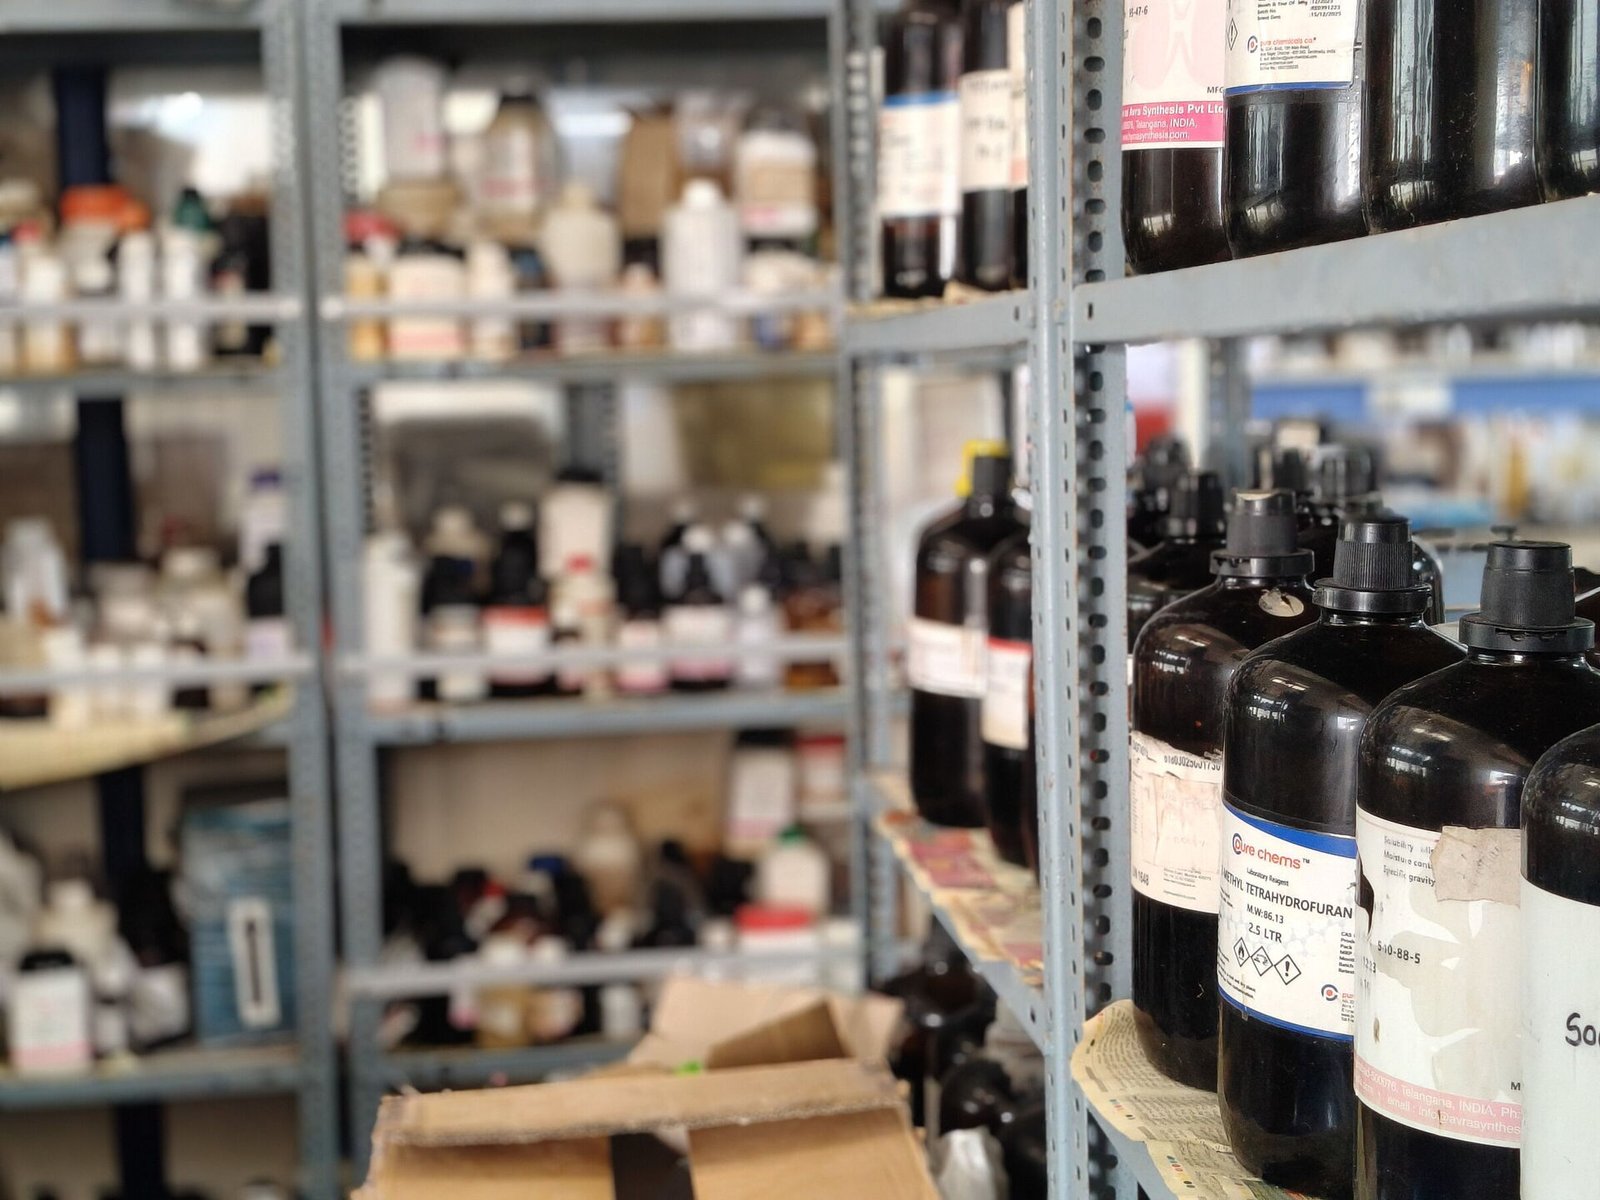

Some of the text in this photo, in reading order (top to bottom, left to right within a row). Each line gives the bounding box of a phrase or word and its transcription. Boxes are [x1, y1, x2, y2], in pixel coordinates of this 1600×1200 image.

[1142, 104, 1184, 117] Synthesis
[1187, 104, 1204, 114] Pvt
[1257, 848, 1301, 870] chems
[1246, 866, 1289, 887] Laboratory Reagent
[1408, 874, 1436, 887] gravity
[1245, 882, 1353, 919] TETRAHYDROFURAN
[1264, 929, 1282, 943] LTR
[1459, 1100, 1496, 1117] INDIA,
